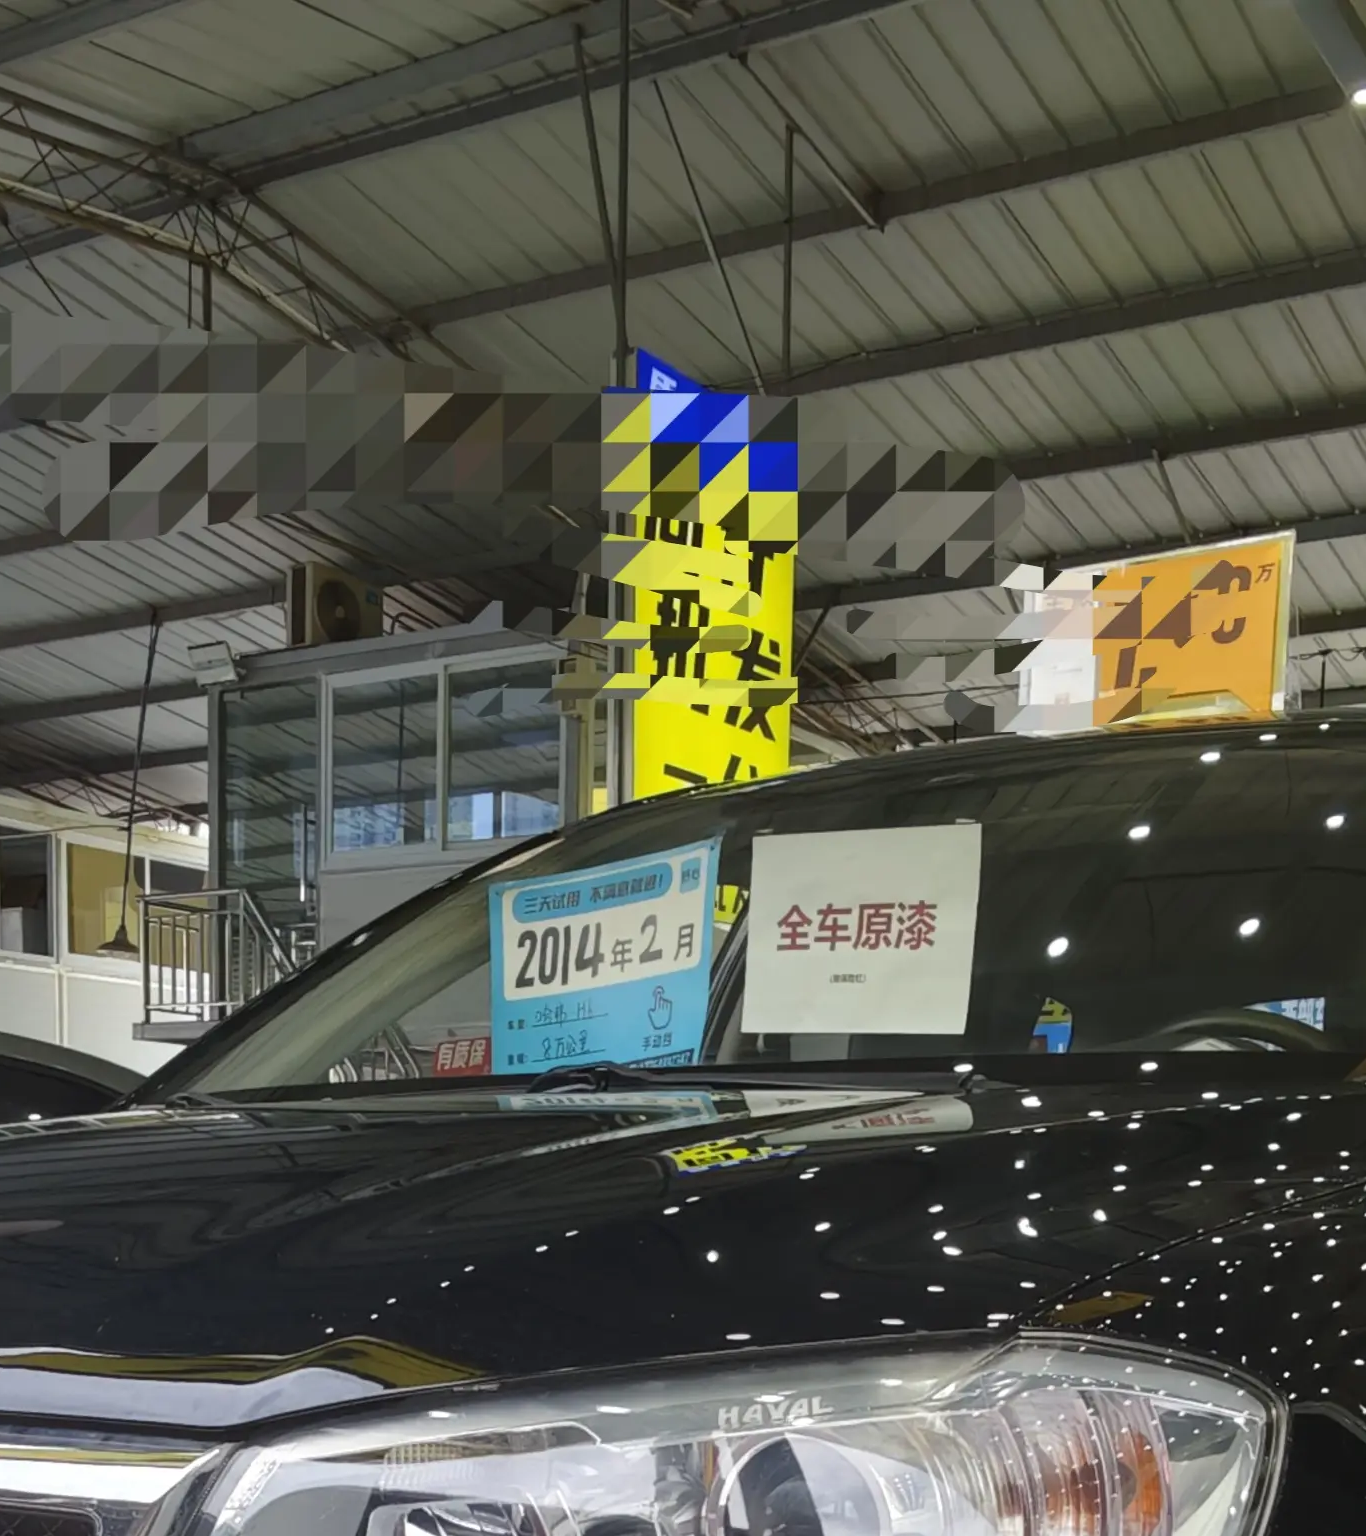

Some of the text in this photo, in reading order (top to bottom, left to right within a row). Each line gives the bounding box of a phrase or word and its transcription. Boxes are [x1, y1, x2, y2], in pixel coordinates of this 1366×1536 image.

[524, 889, 581, 914] 三天试用
[776, 900, 937, 951] 全车原漆
[436, 1038, 487, 1071] 有质保
[718, 1396, 834, 1429] HAVAL
